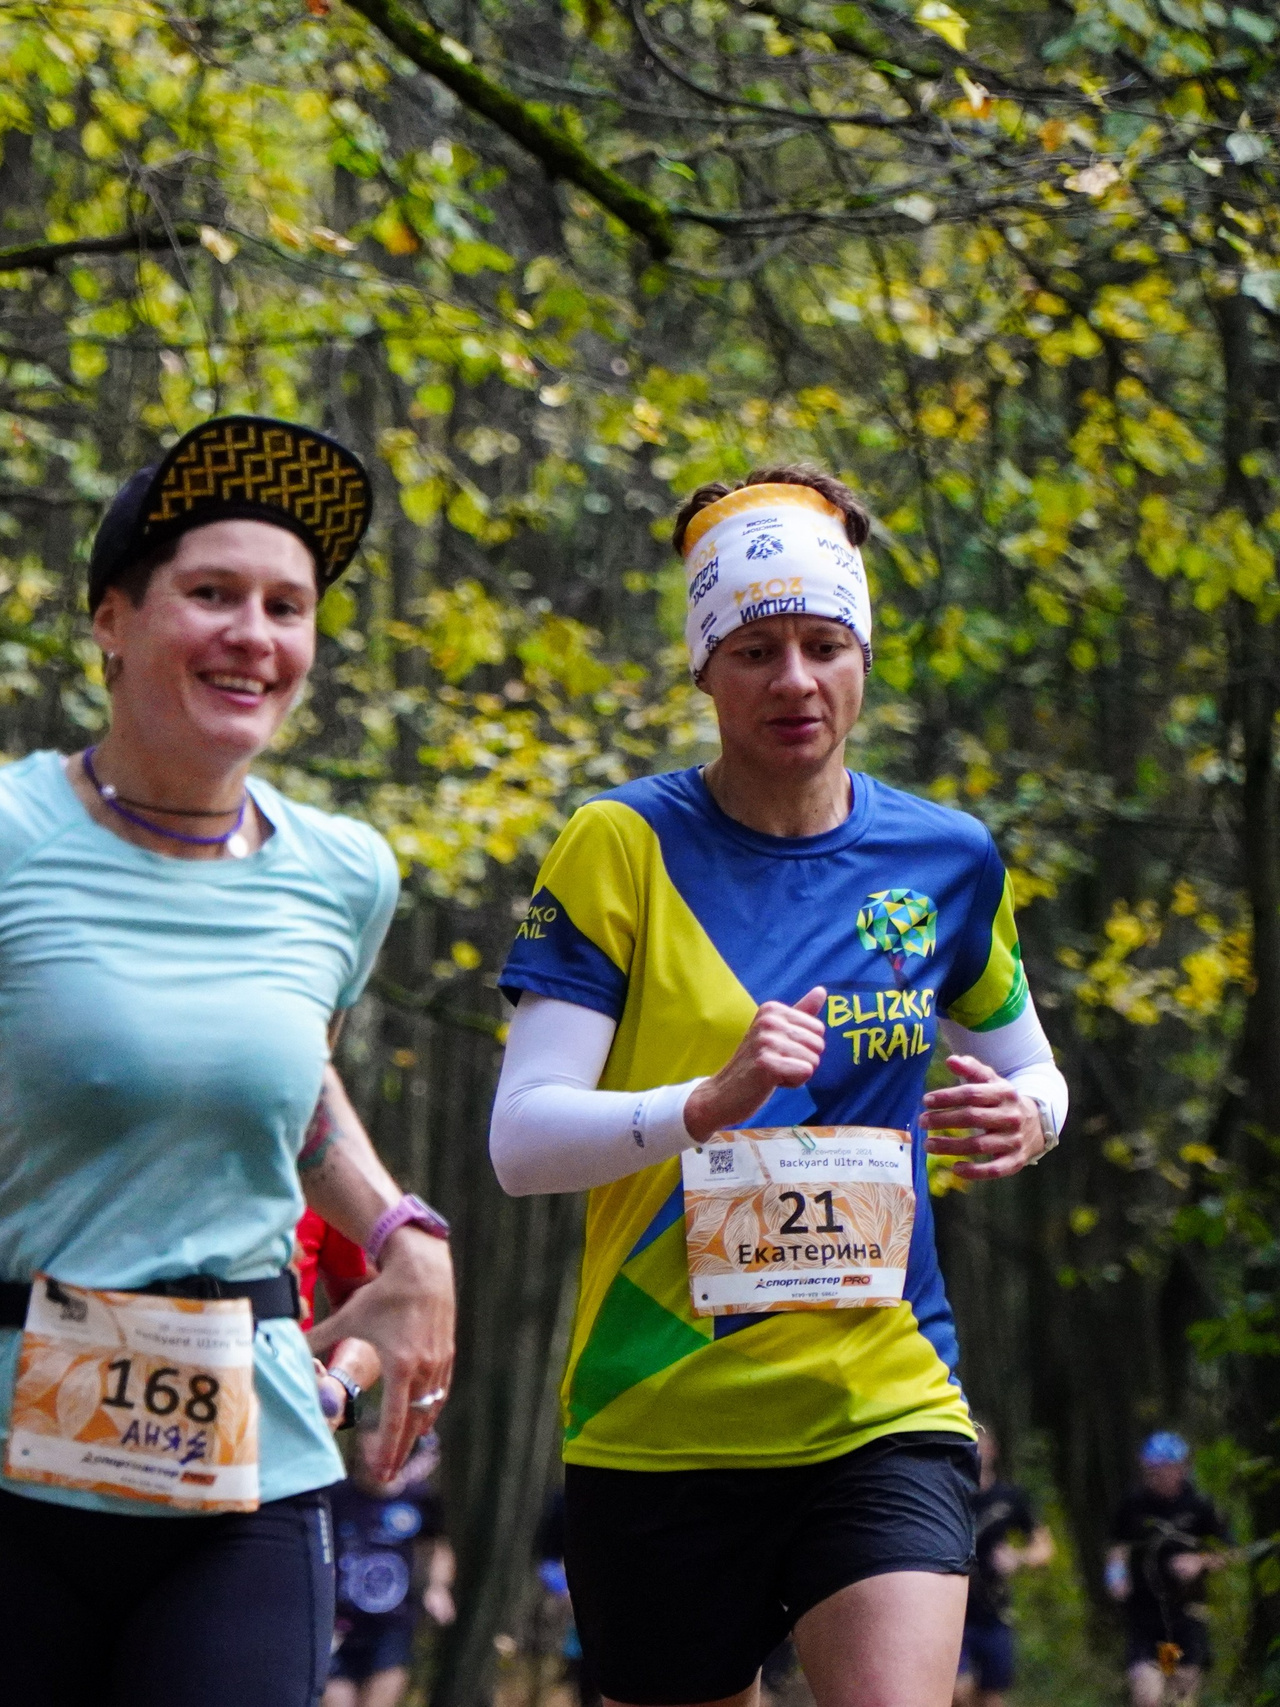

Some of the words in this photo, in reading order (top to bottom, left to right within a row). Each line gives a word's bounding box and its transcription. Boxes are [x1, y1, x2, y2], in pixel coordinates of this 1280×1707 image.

[842, 1023, 931, 1065] TRAIL
[779, 1158, 829, 1169] Backyard
[834, 1158, 864, 1167] Ultra
[868, 1158, 899, 1168] Moscow
[778, 1190, 844, 1235] 21
[738, 1243, 882, 1267] Екатерина
[842, 1275, 872, 1286] PRO
[102, 1358, 219, 1424] 168
